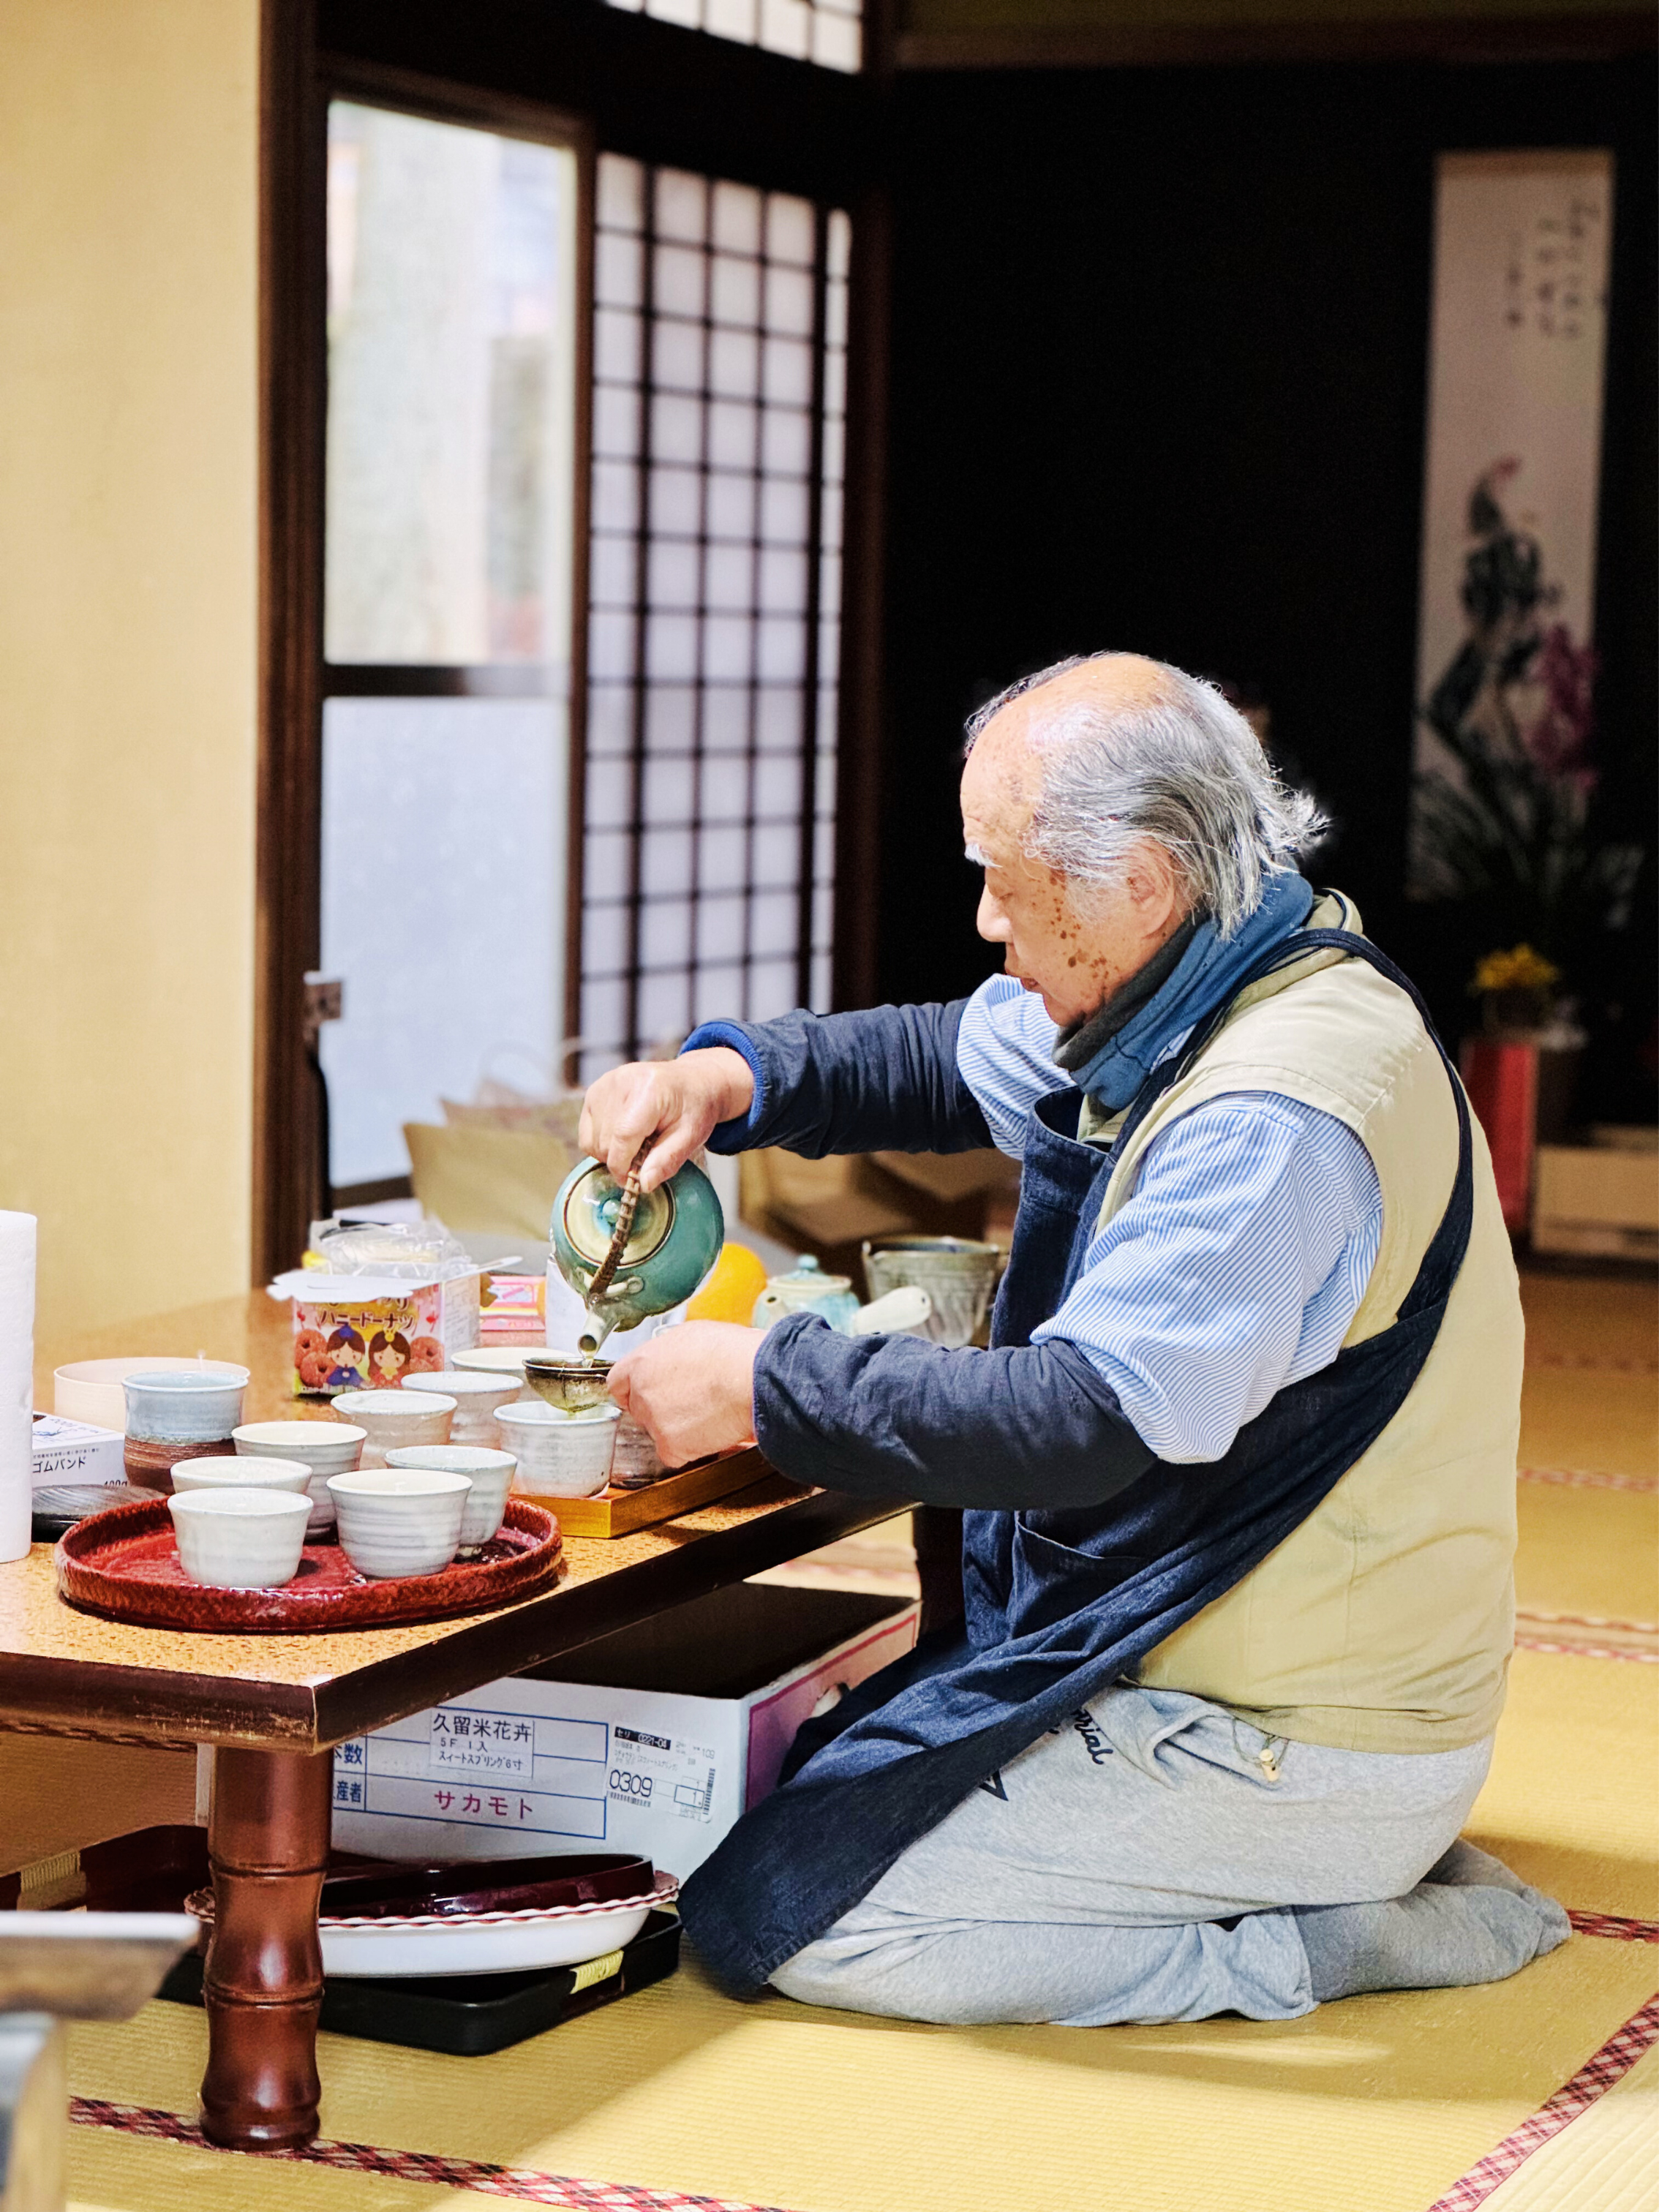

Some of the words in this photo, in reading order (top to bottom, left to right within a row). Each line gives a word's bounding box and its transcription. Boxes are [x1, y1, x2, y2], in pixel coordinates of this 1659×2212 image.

[32, 1456, 86, 1473] ゴムバンド
[433, 1713, 532, 1742] 久留米花卉
[334, 1780, 362, 1803] 産者
[609, 1769, 653, 1797] 0309
[434, 1790, 533, 1820] サカモト
